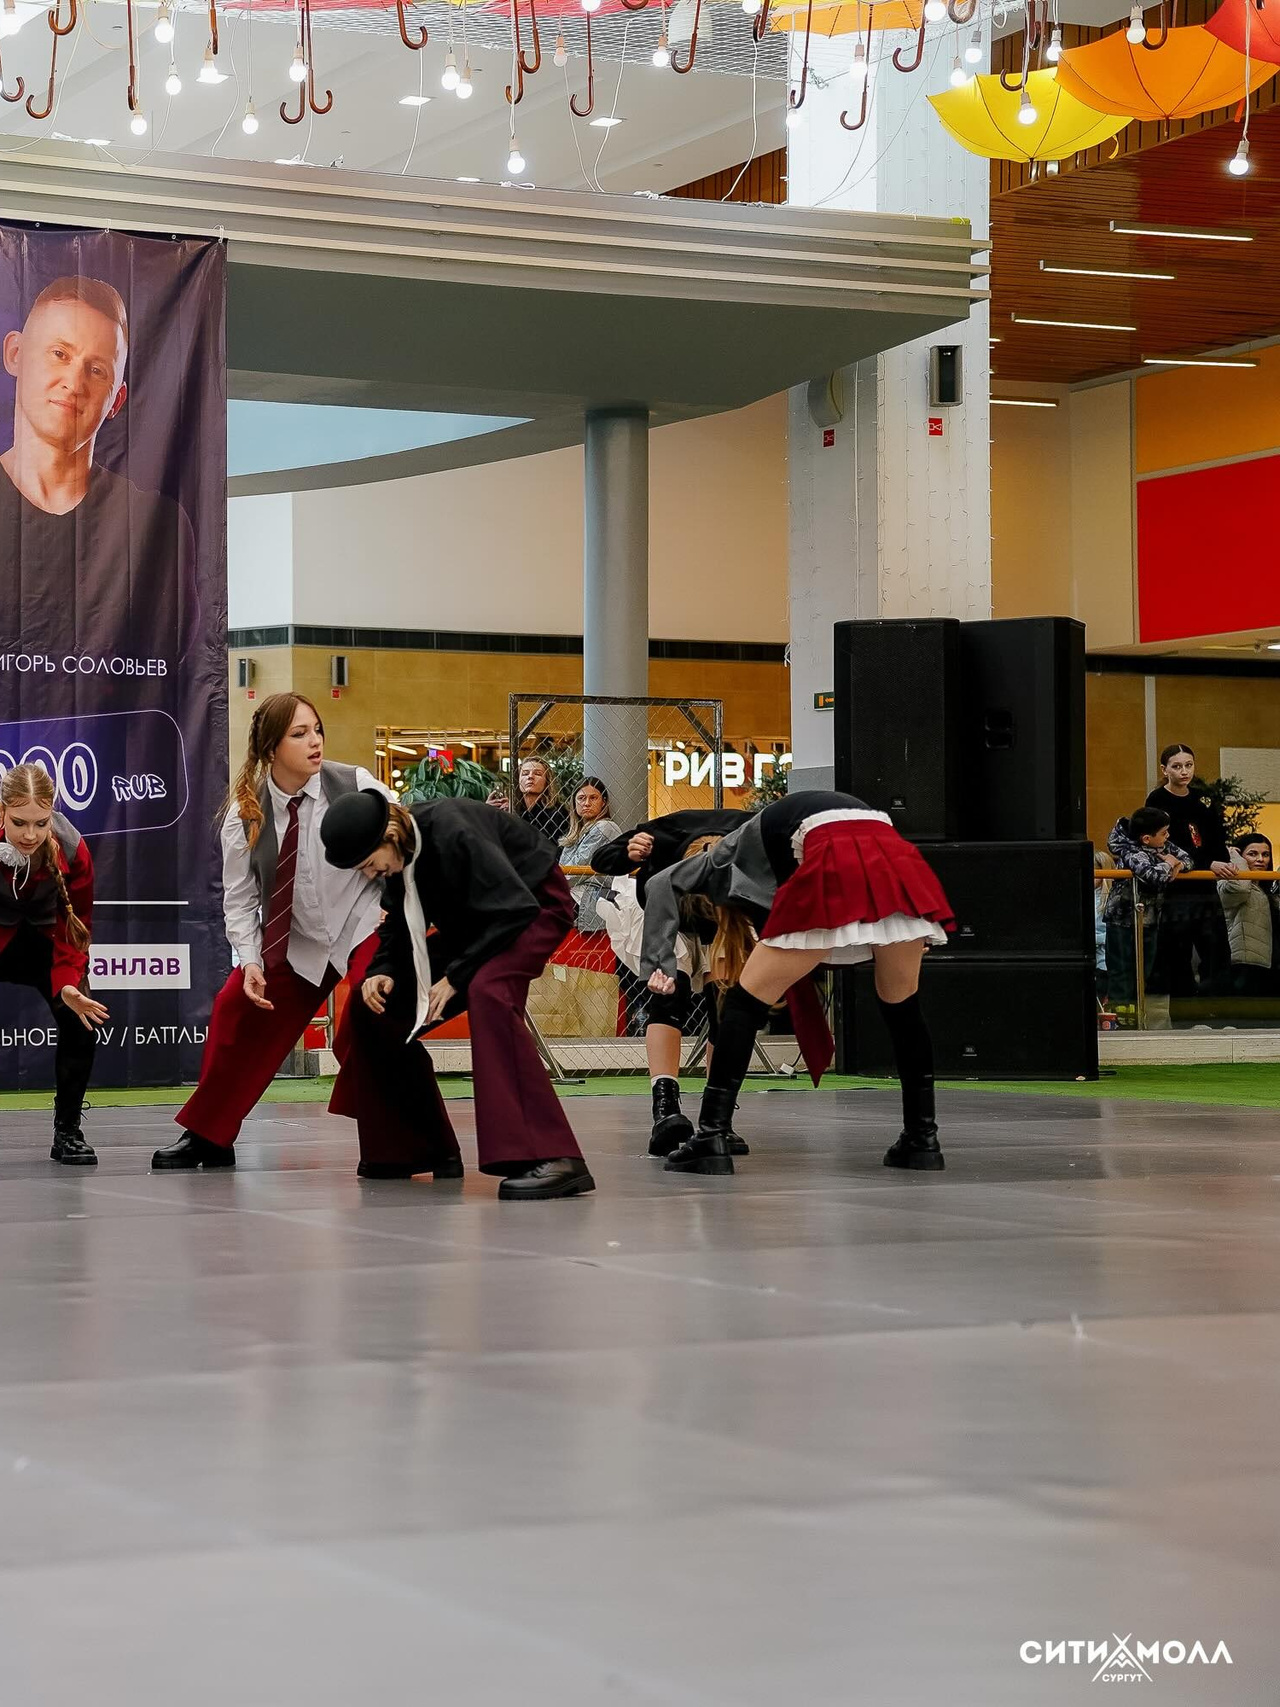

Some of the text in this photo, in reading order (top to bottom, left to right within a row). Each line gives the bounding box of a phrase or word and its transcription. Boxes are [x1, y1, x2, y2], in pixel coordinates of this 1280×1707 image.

[62, 655, 168, 676] СОЛОВЬЕВ
[665, 751, 745, 788] РИВ
[111, 773, 167, 801] RUB
[87, 956, 181, 976] анлав
[135, 1026, 209, 1044] БАТТЛЫ
